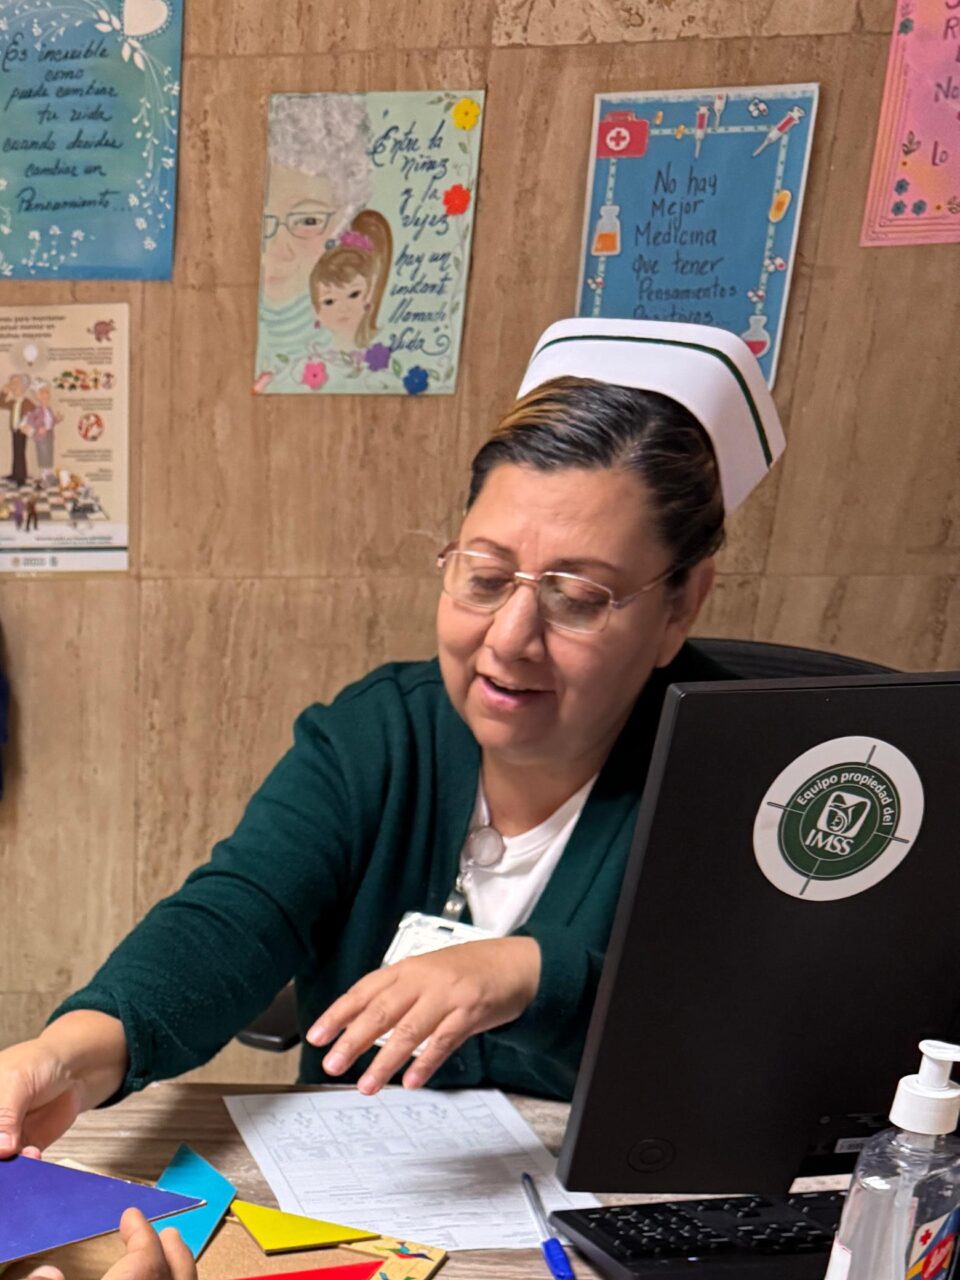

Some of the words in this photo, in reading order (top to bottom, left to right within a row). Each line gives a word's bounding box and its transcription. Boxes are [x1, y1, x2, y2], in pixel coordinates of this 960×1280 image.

[44, 69, 84, 82] como
[654, 161, 677, 195] No
[687, 165, 718, 196] hay
[651, 197, 704, 231] Mejor
[635, 220, 717, 247] Medicina
[671, 249, 725, 276] tener
[637, 275, 737, 302] Pensamientos
[796, 774, 838, 806] Equipo
[840, 772, 893, 806] propiedad
[882, 806, 894, 826] del
[805, 829, 854, 856] IMSS
